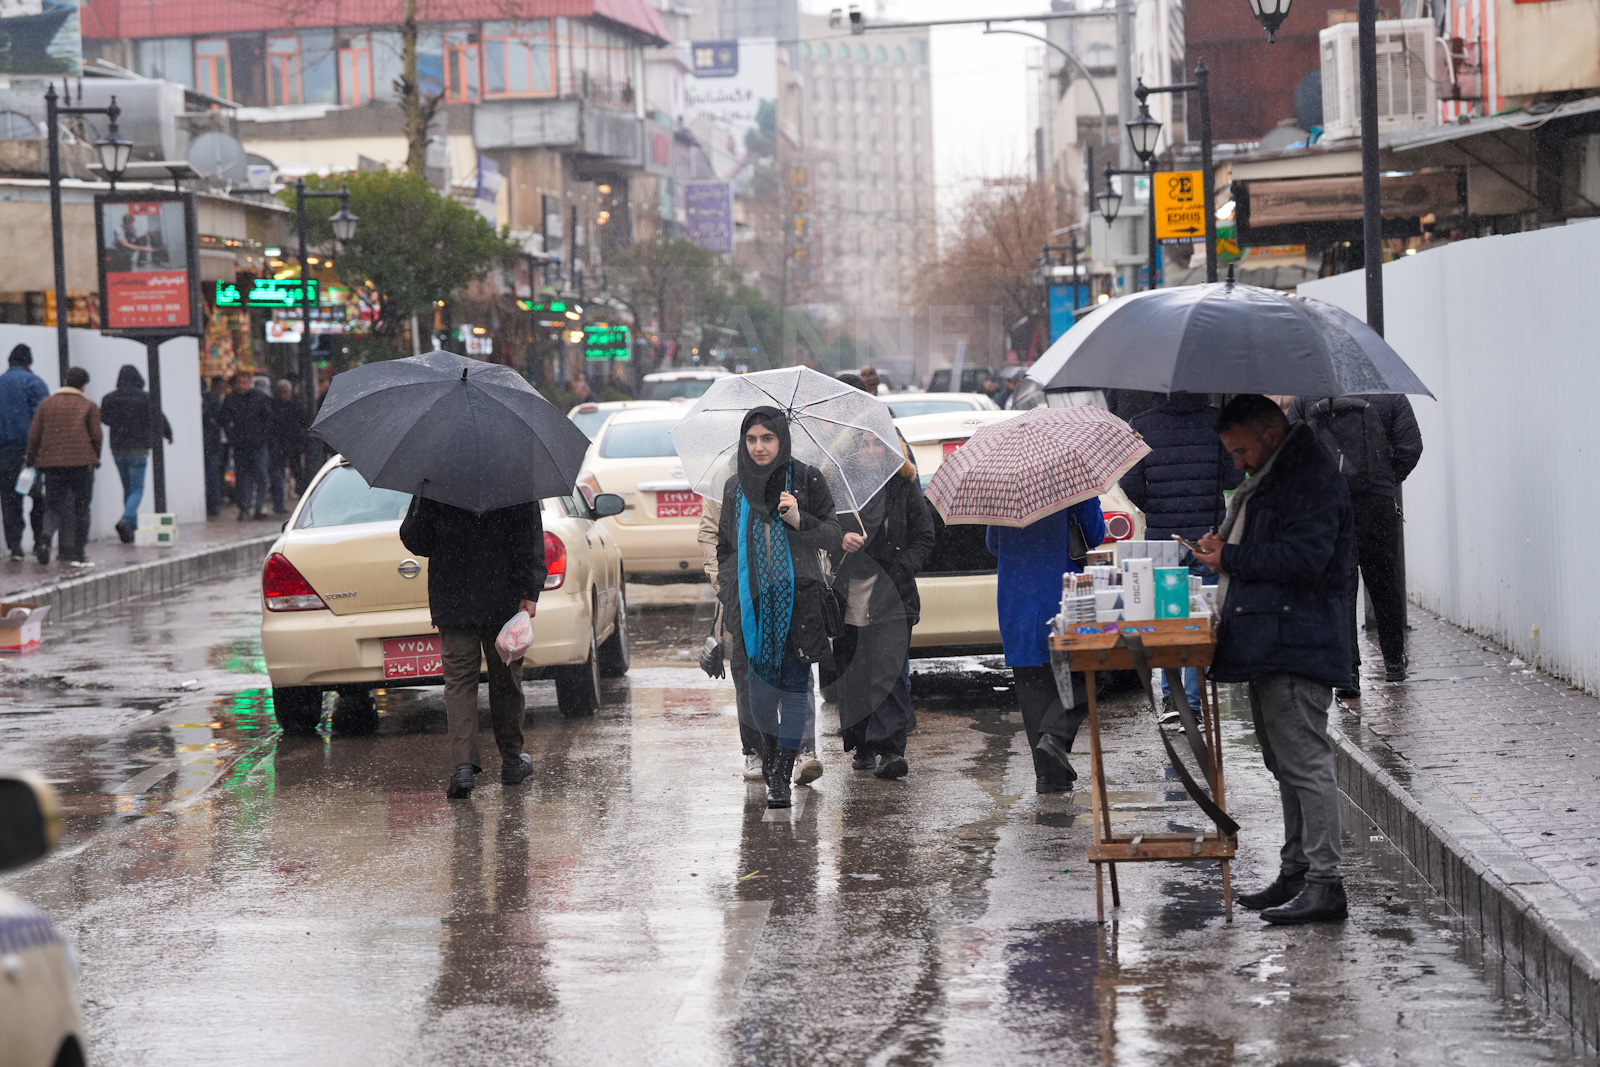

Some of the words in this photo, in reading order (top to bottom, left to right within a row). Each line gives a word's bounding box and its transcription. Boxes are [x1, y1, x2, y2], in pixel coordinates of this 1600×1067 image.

[1167, 211, 1201, 222] EDRIS
[1132, 572, 1141, 604] OSCAR
[324, 590, 358, 600] SUNNY
[398, 641, 434, 653] ٧٧٥٨
